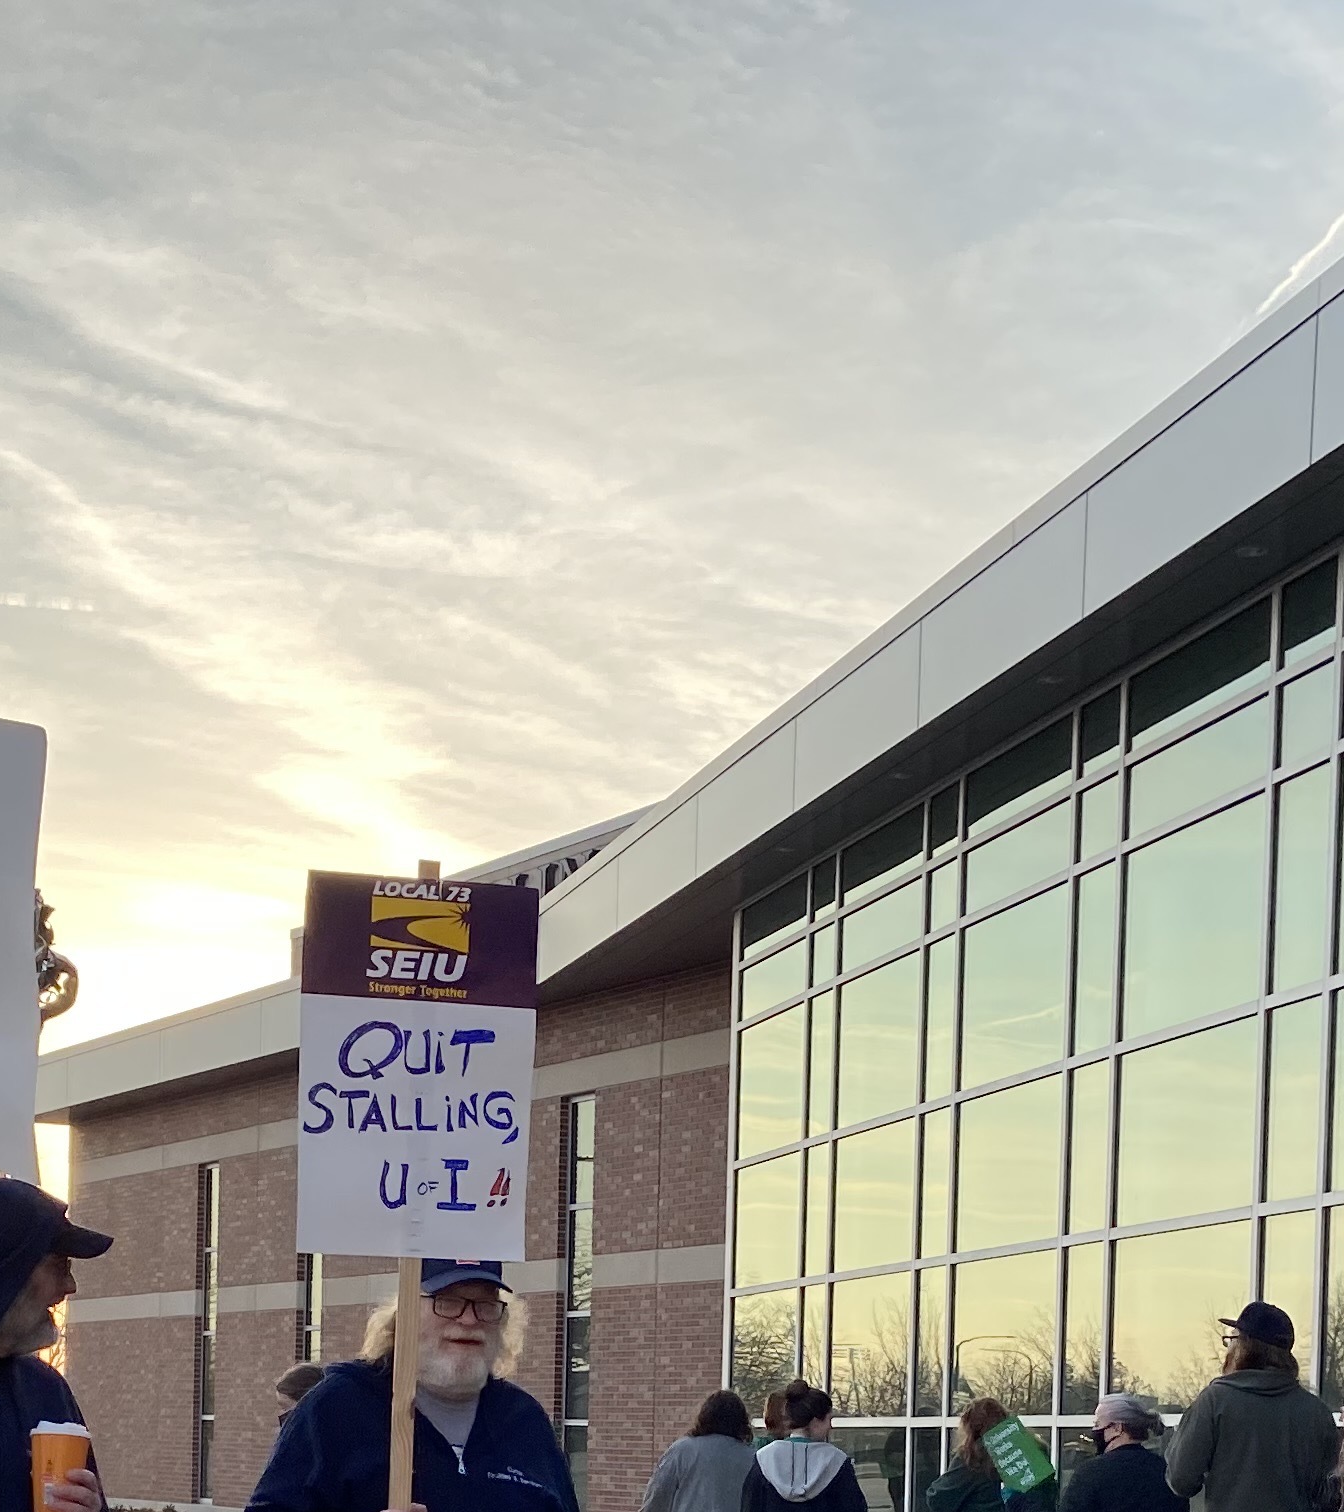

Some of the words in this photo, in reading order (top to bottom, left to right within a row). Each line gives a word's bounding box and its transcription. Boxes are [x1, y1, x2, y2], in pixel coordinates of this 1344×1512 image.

[373, 879, 440, 901] LOCAL
[446, 886, 472, 902] 73
[366, 949, 468, 983] SEIU
[369, 981, 416, 996] Stronger
[419, 985, 467, 999] Together
[378, 1159, 409, 1210] U
[436, 1159, 476, 1211] I
